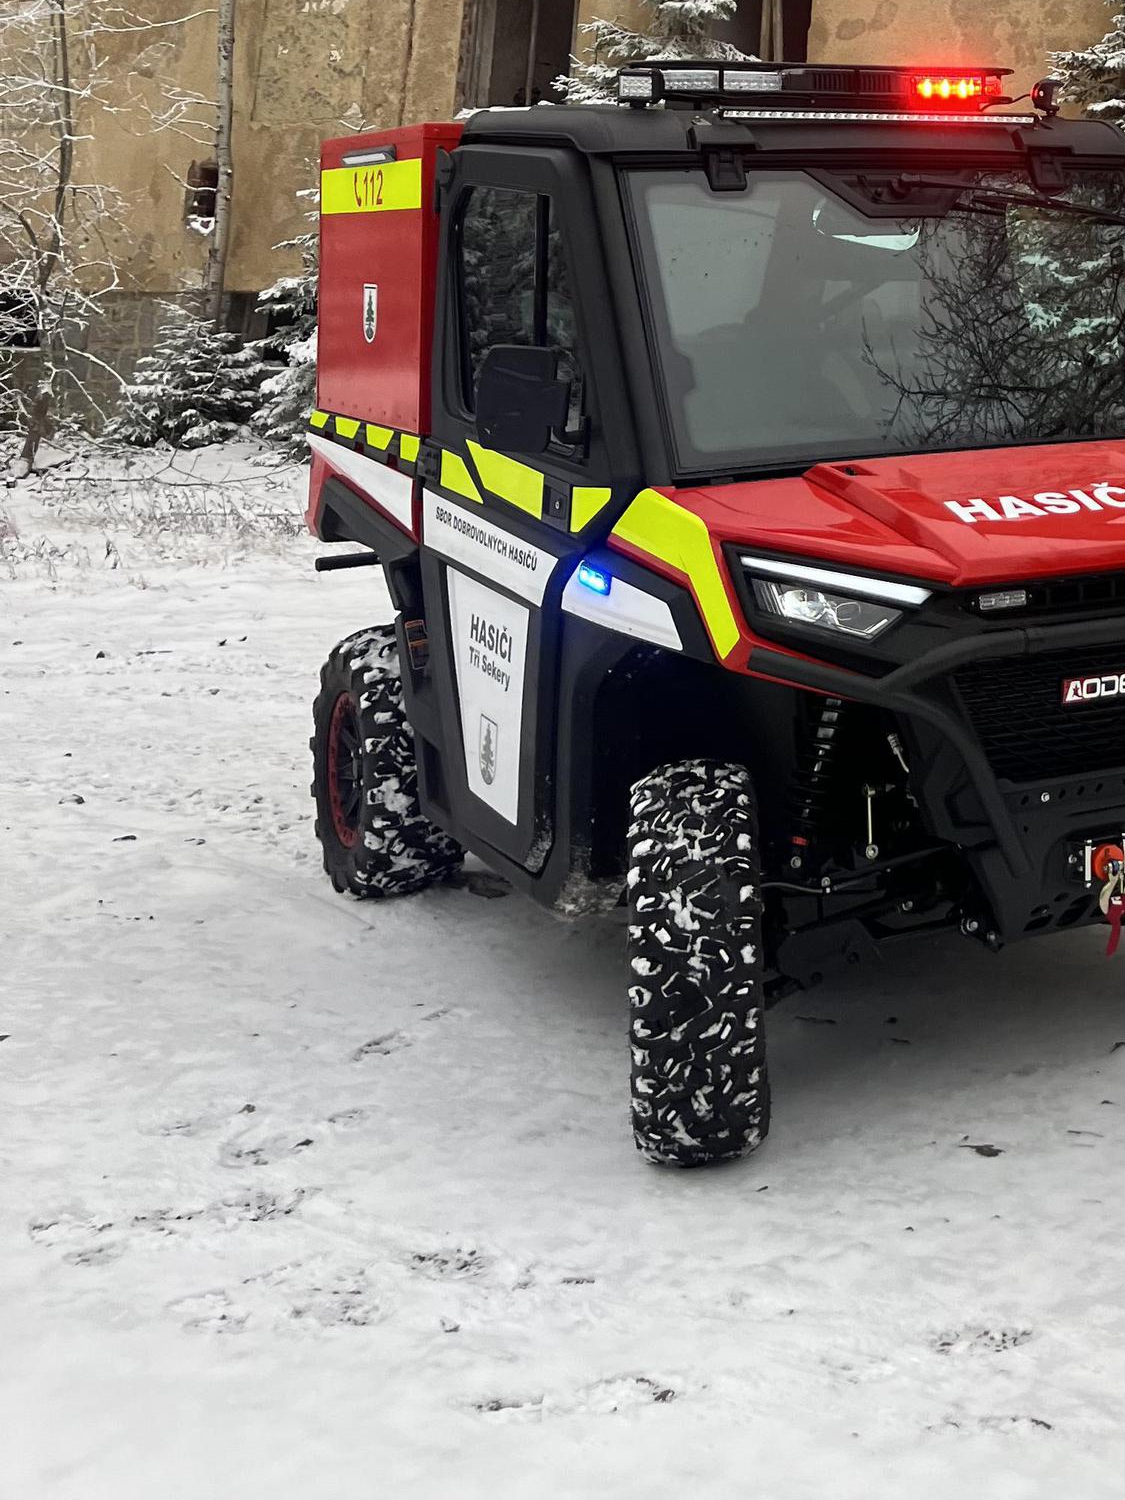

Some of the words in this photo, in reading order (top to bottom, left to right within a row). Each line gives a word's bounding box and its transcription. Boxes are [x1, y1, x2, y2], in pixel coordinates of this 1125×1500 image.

[363, 169, 383, 206] 112
[435, 506, 452, 527] SBOR
[470, 613, 512, 663] HASIČI
[481, 654, 510, 692] Sekery
